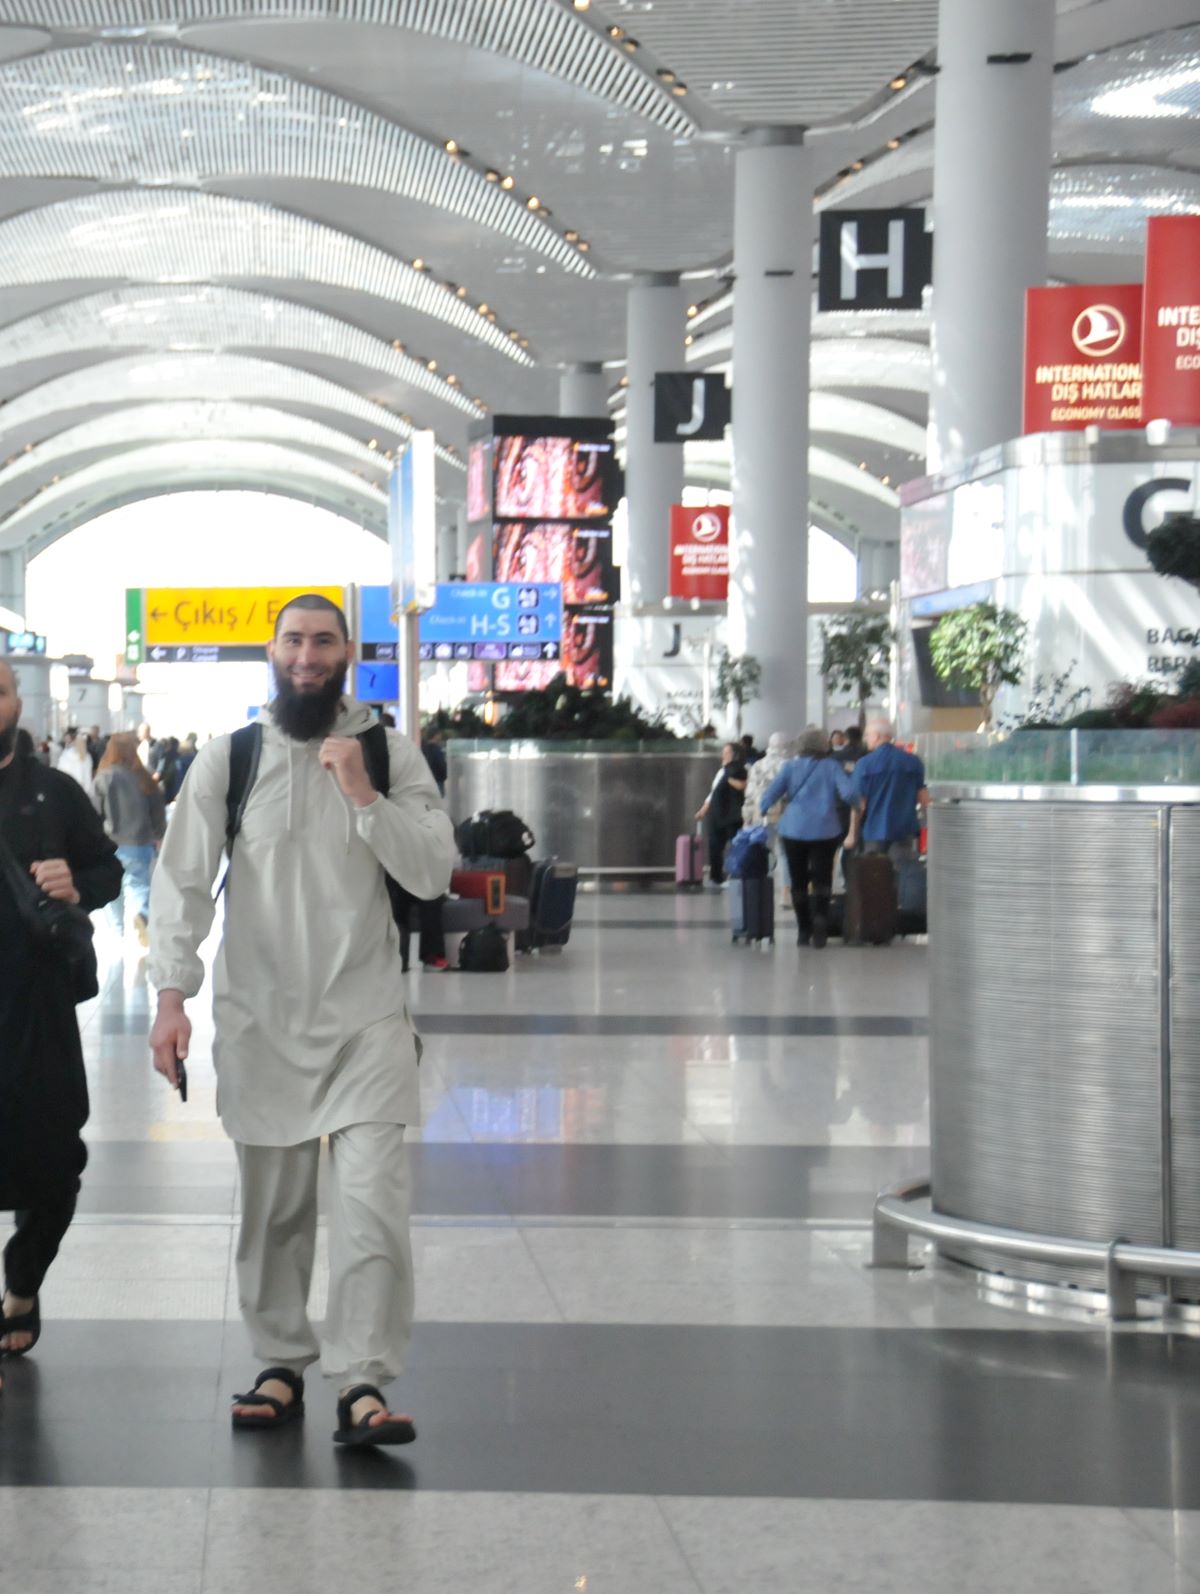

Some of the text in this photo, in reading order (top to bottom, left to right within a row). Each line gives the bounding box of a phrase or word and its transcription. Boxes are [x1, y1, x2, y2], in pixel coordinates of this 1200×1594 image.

[841, 220, 904, 300] H
[676, 378, 705, 435] J
[1051, 384, 1078, 404] DIŞ
[1051, 406, 1106, 421] ECONOMY
[1123, 477, 1193, 551] G
[491, 587, 510, 610] G
[174, 600, 238, 631] Çıkış
[246, 601, 257, 625] /
[471, 614, 510, 636] H-S
[663, 624, 682, 658] J
